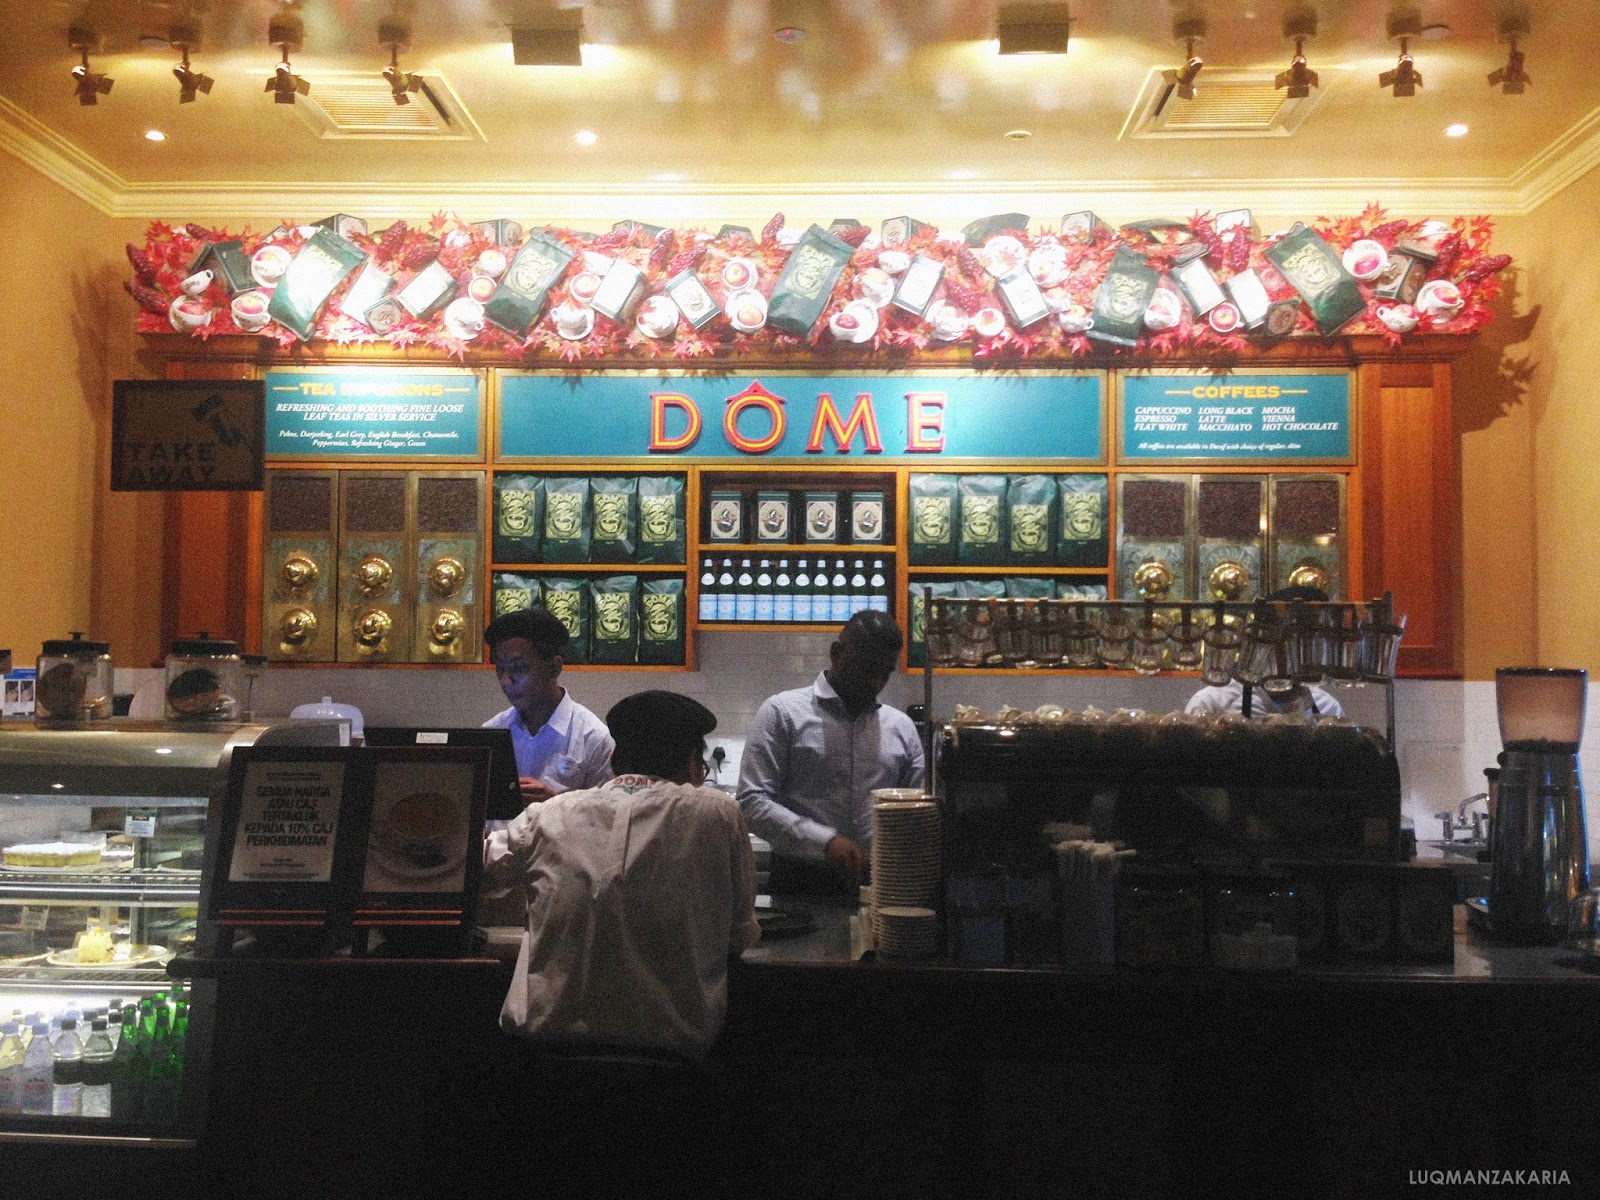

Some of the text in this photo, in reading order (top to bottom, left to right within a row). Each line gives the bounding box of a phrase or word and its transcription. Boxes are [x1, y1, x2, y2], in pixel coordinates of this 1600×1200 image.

[300, 383, 336, 395] TEA
[1192, 385, 1280, 398] COFFEES
[276, 403, 464, 413] REFRESHING AND SOOTHING FINE LOOSE
[303, 412, 437, 421] LEAF TEAS IN SILVER SERVICE
[648, 380, 947, 453] DÔME
[1134, 415, 1177, 423] ESPRESSO
[1198, 415, 1227, 423] LATTE
[1134, 423, 1188, 431] FLAT WHITE
[1198, 423, 1252, 431] MACCHIATO
[1261, 422, 1339, 431] HOT CHOCOLATE
[335, 430, 349, 438] Earl
[126, 442, 215, 461] TAKE
[126, 466, 216, 483] AWAY
[244, 822, 333, 833] KEPADA 10% CAJ
[246, 835, 328, 846] PERKHIDMATAN
